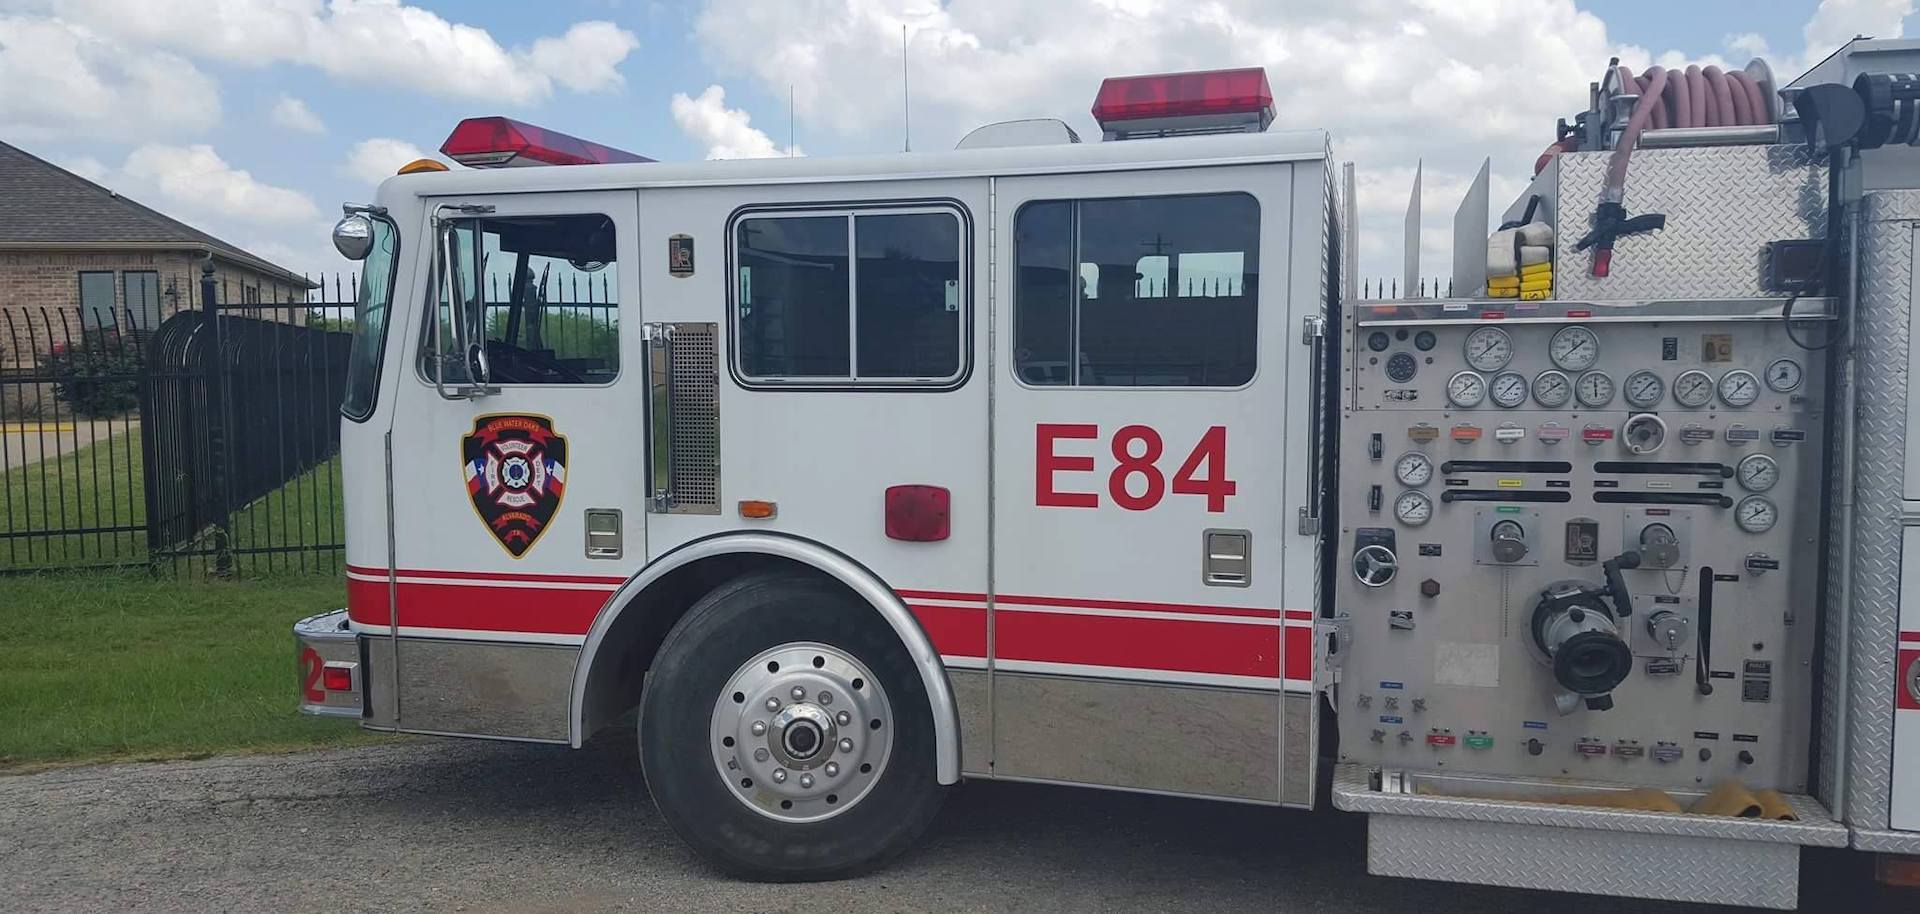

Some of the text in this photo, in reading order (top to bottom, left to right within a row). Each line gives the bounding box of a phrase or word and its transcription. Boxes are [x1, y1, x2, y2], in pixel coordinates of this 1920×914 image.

[487, 422, 503, 432] BLUE
[523, 422, 540, 432] OAKS
[500, 442, 528, 452] VOLUNTEER
[1036, 423, 1236, 513] E84
[302, 647, 326, 702] 2
